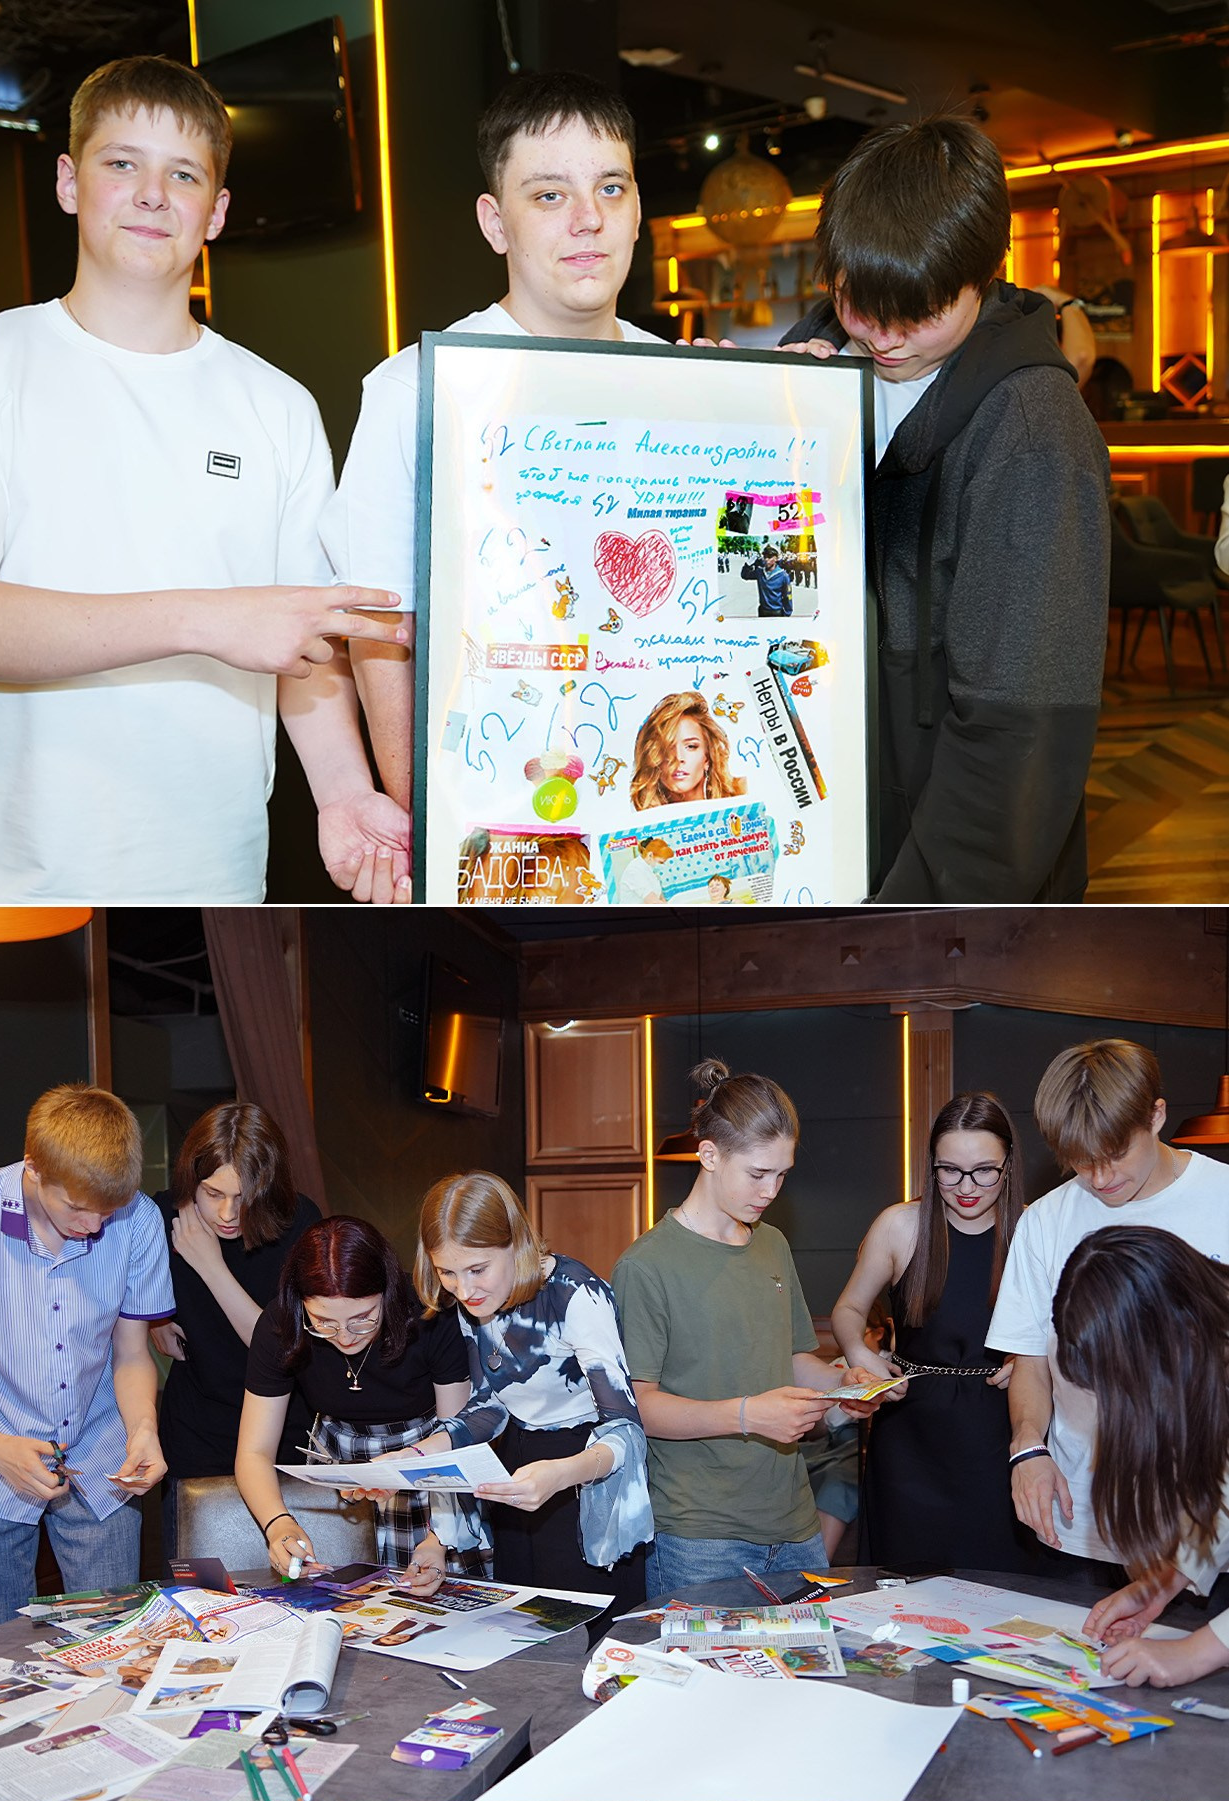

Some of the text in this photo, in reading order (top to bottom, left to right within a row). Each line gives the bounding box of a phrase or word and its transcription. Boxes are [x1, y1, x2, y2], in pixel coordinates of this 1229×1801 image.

[524, 424, 617, 452] Светлана
[592, 492, 620, 517] 52
[627, 507, 708, 519] Милая тиранка
[777, 501, 804, 523] 52
[677, 576, 726, 625] 52
[737, 736, 765, 768] 52
[753, 678, 813, 809] Негры в России
[489, 841, 540, 854] ЖАННА
[680, 829, 715, 844] Едем в
[675, 845, 692, 858] как
[694, 842, 720, 855] взять
[714, 841, 770, 862] от лечения?
[63, 1643, 115, 1662] ХОЧЕТСЯ
[70, 1643, 129, 1666] ЕДИМ ЧТО
